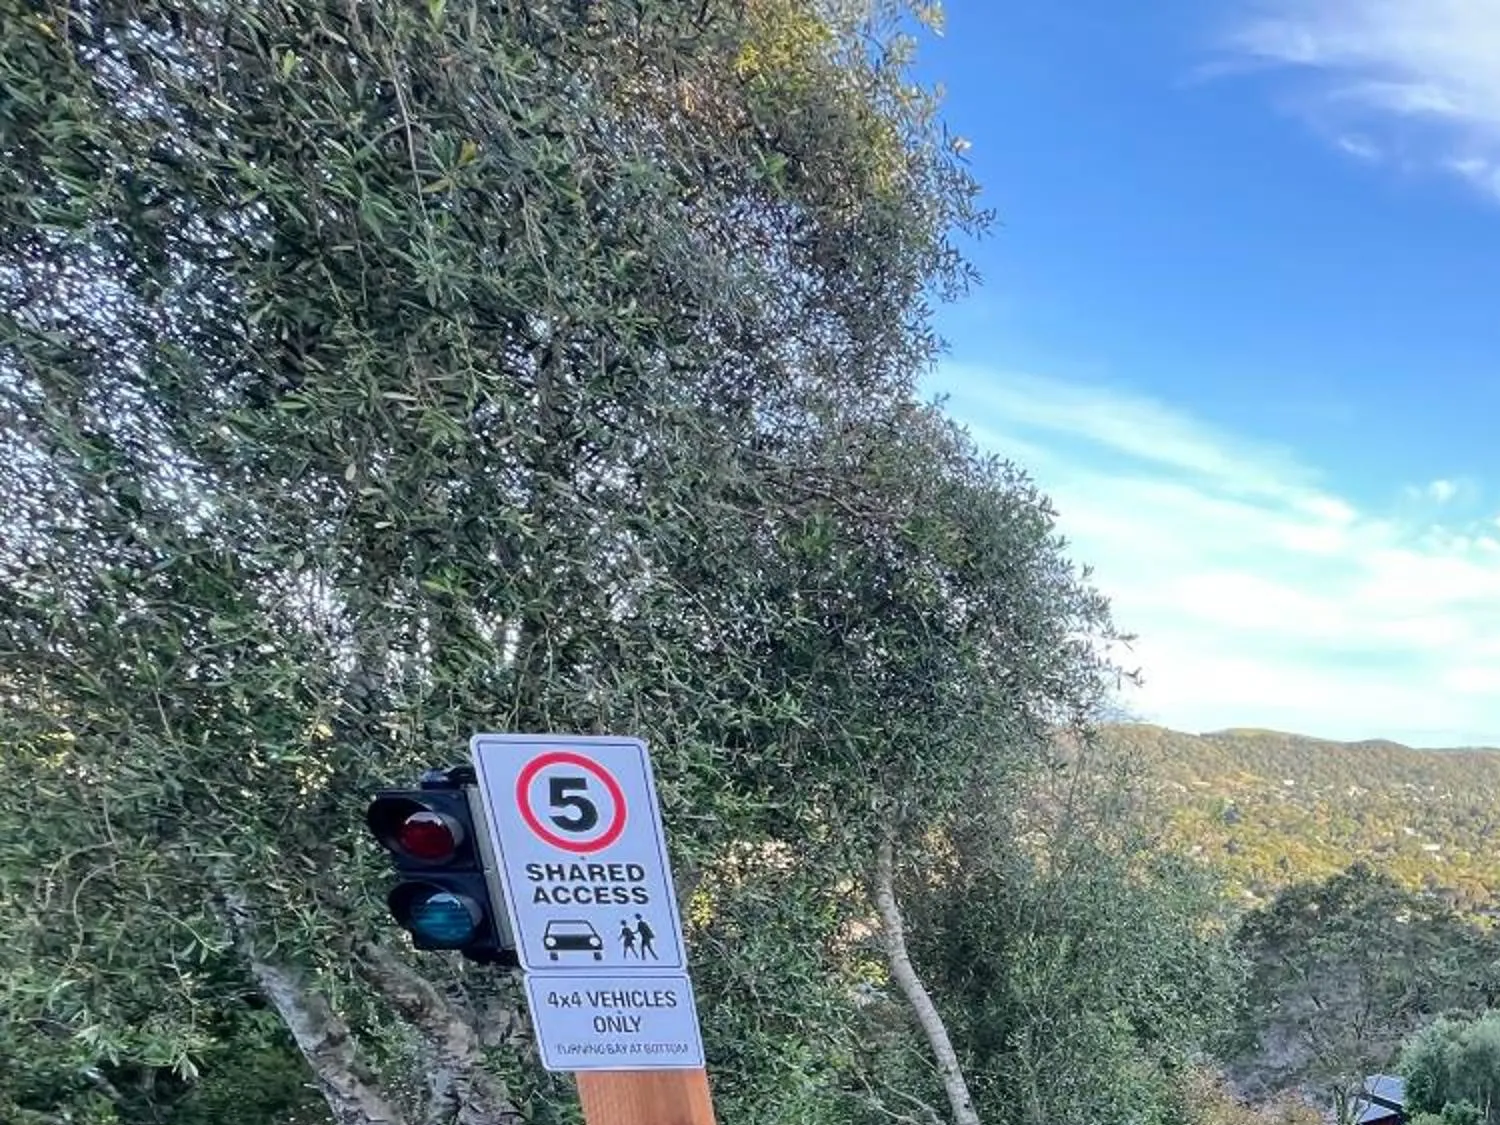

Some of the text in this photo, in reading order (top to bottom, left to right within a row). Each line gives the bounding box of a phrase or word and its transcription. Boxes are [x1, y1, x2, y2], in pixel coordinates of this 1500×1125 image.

[547, 776, 599, 833] 5
[525, 862, 646, 883] SHARED
[532, 885, 650, 905] ACCESS
[547, 990, 678, 1009] 4x4 VEHICLES
[592, 1015, 642, 1034] ONLY
